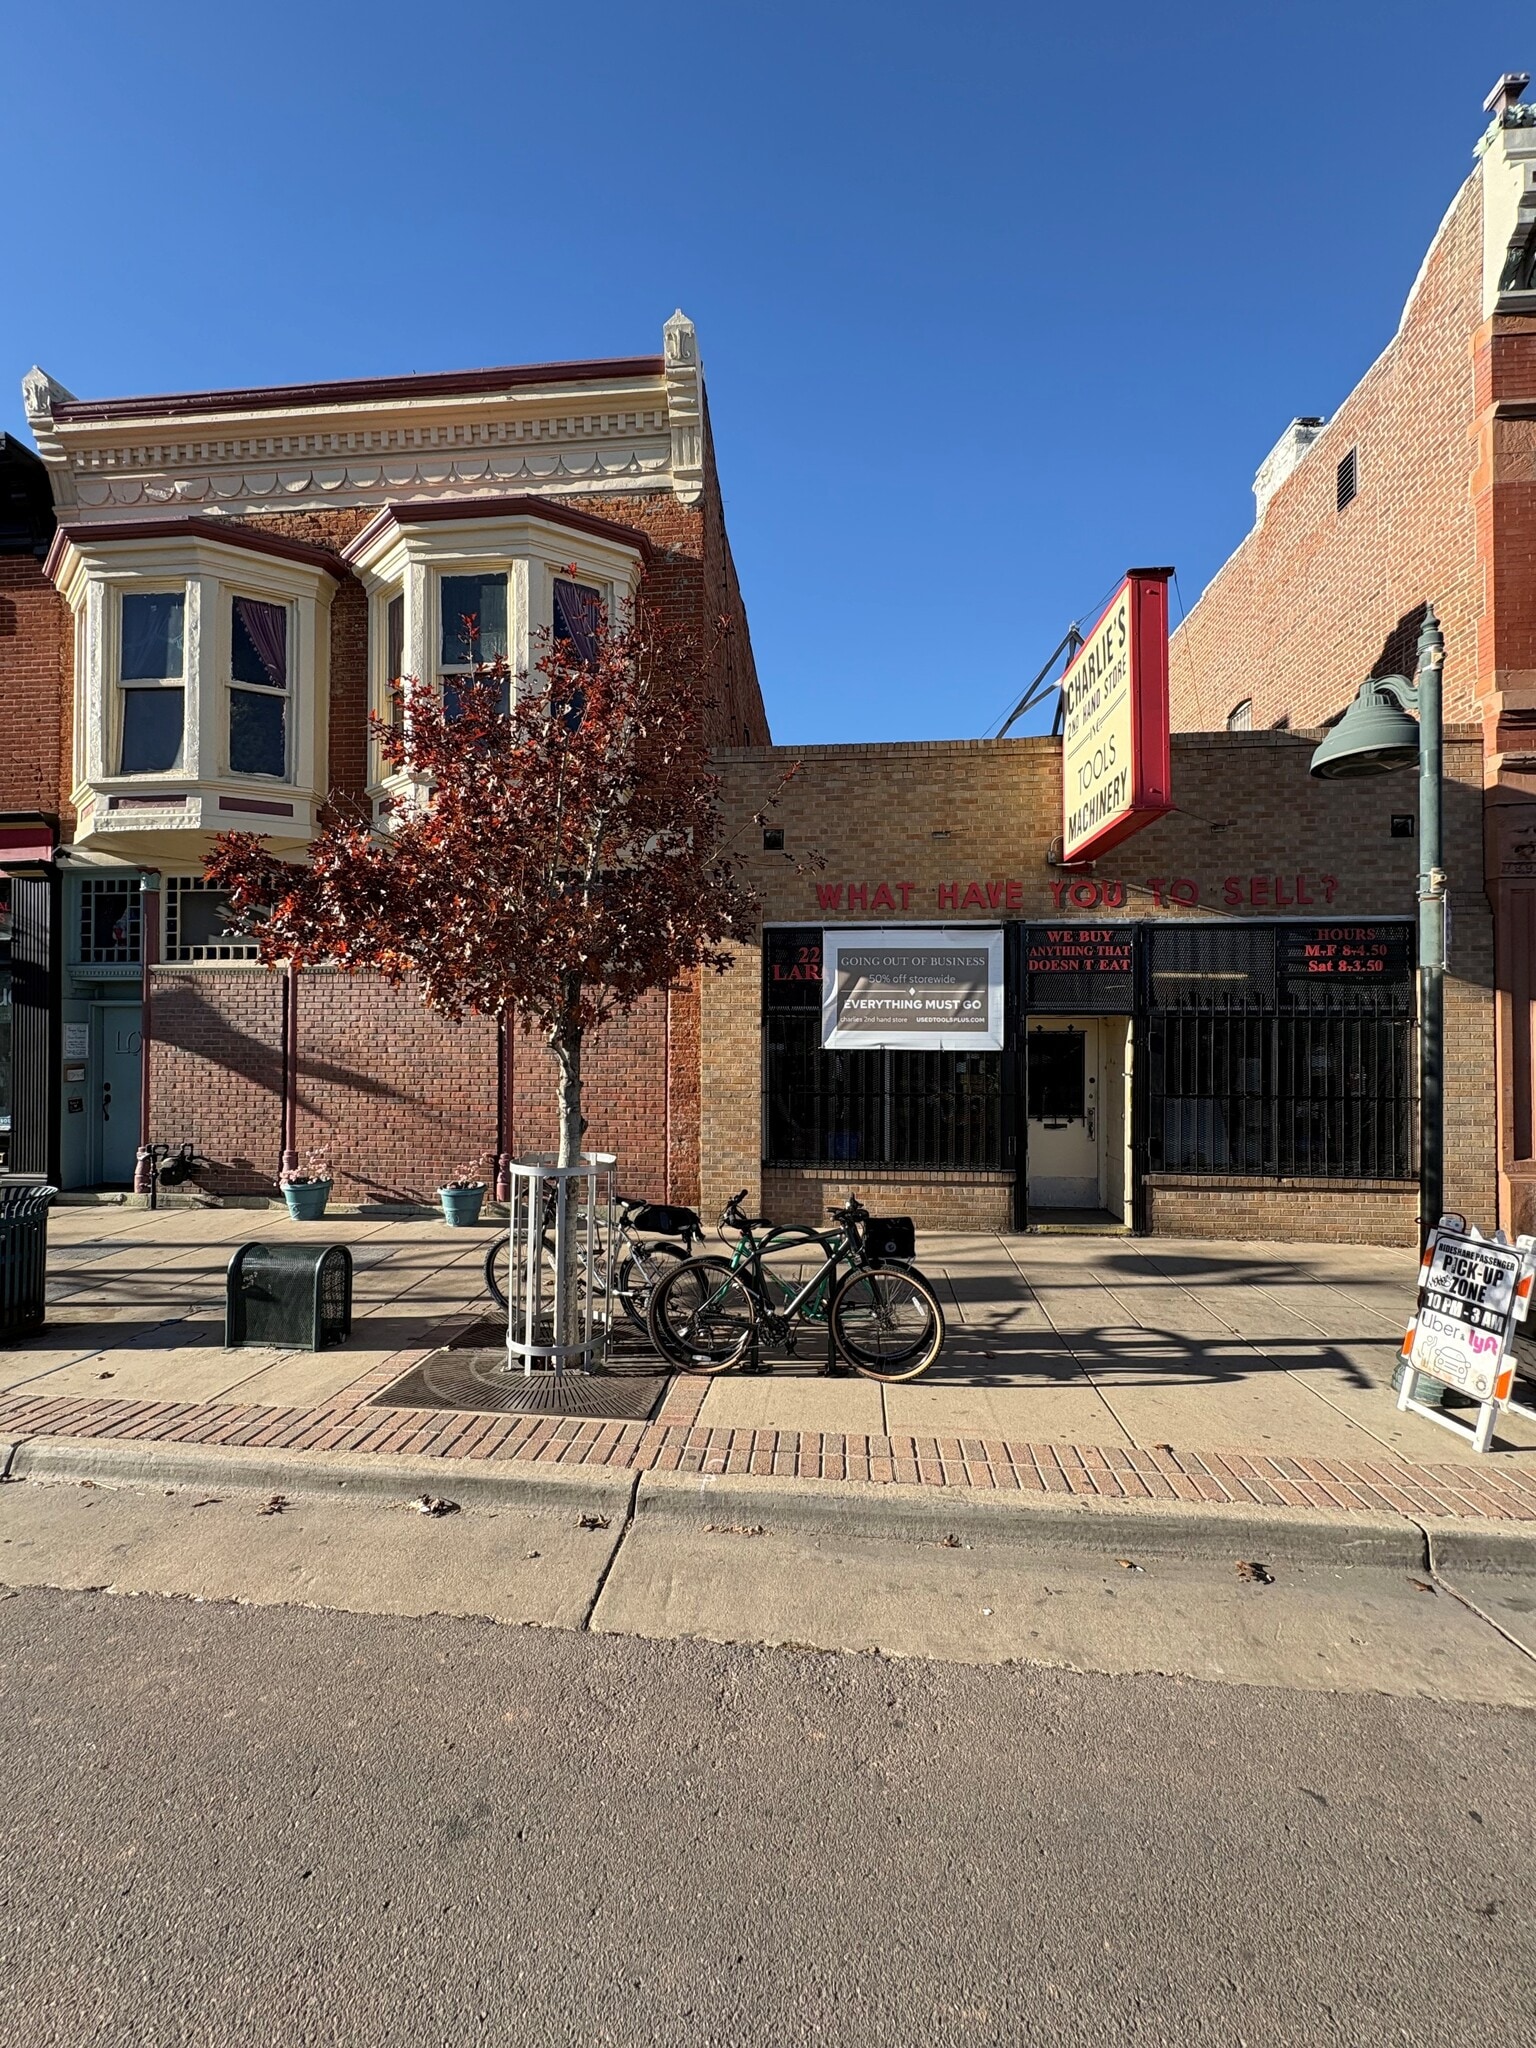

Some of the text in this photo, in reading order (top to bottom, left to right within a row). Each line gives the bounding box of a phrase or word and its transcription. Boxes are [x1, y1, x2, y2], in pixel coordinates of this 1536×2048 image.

[1067, 605, 1126, 715] CHARLIE'S
[1082, 688, 1101, 726] HAND
[1104, 652, 1127, 700] STORE
[1077, 734, 1116, 795] TOOLS
[1068, 766, 1128, 844] MACHINERY
[816, 875, 1339, 910] WHAT HAVE YOU TO SELL?
[1046, 930, 1113, 943] WE BUY
[1317, 928, 1376, 940] HOURS
[1029, 945, 1131, 957] ANYTHING THAT
[1303, 944, 1337, 957] M-F
[841, 956, 985, 966] GOING OUT OF BUSINESS
[1099, 959, 1131, 971] EAT
[1308, 960, 1334, 972] Sat
[868, 973, 956, 984] 50% off storewide
[844, 999, 982, 1010] EVERYTHING MUST GO
[840, 1015, 863, 1023] charlies
[864, 1015, 875, 1023] 2nd
[1438, 1243, 1516, 1272] RIDESHARE PASSENGER
[1442, 1254, 1504, 1287] PICK-UP
[1449, 1276, 1488, 1303] ZONE
[1427, 1292, 1442, 1310] 10
[1441, 1297, 1464, 1318] PM
[1470, 1307, 1481, 1324] 3
[1481, 1311, 1505, 1333] AM
[1422, 1310, 1460, 1338] Uber
[1468, 1329, 1498, 1356] lyft
